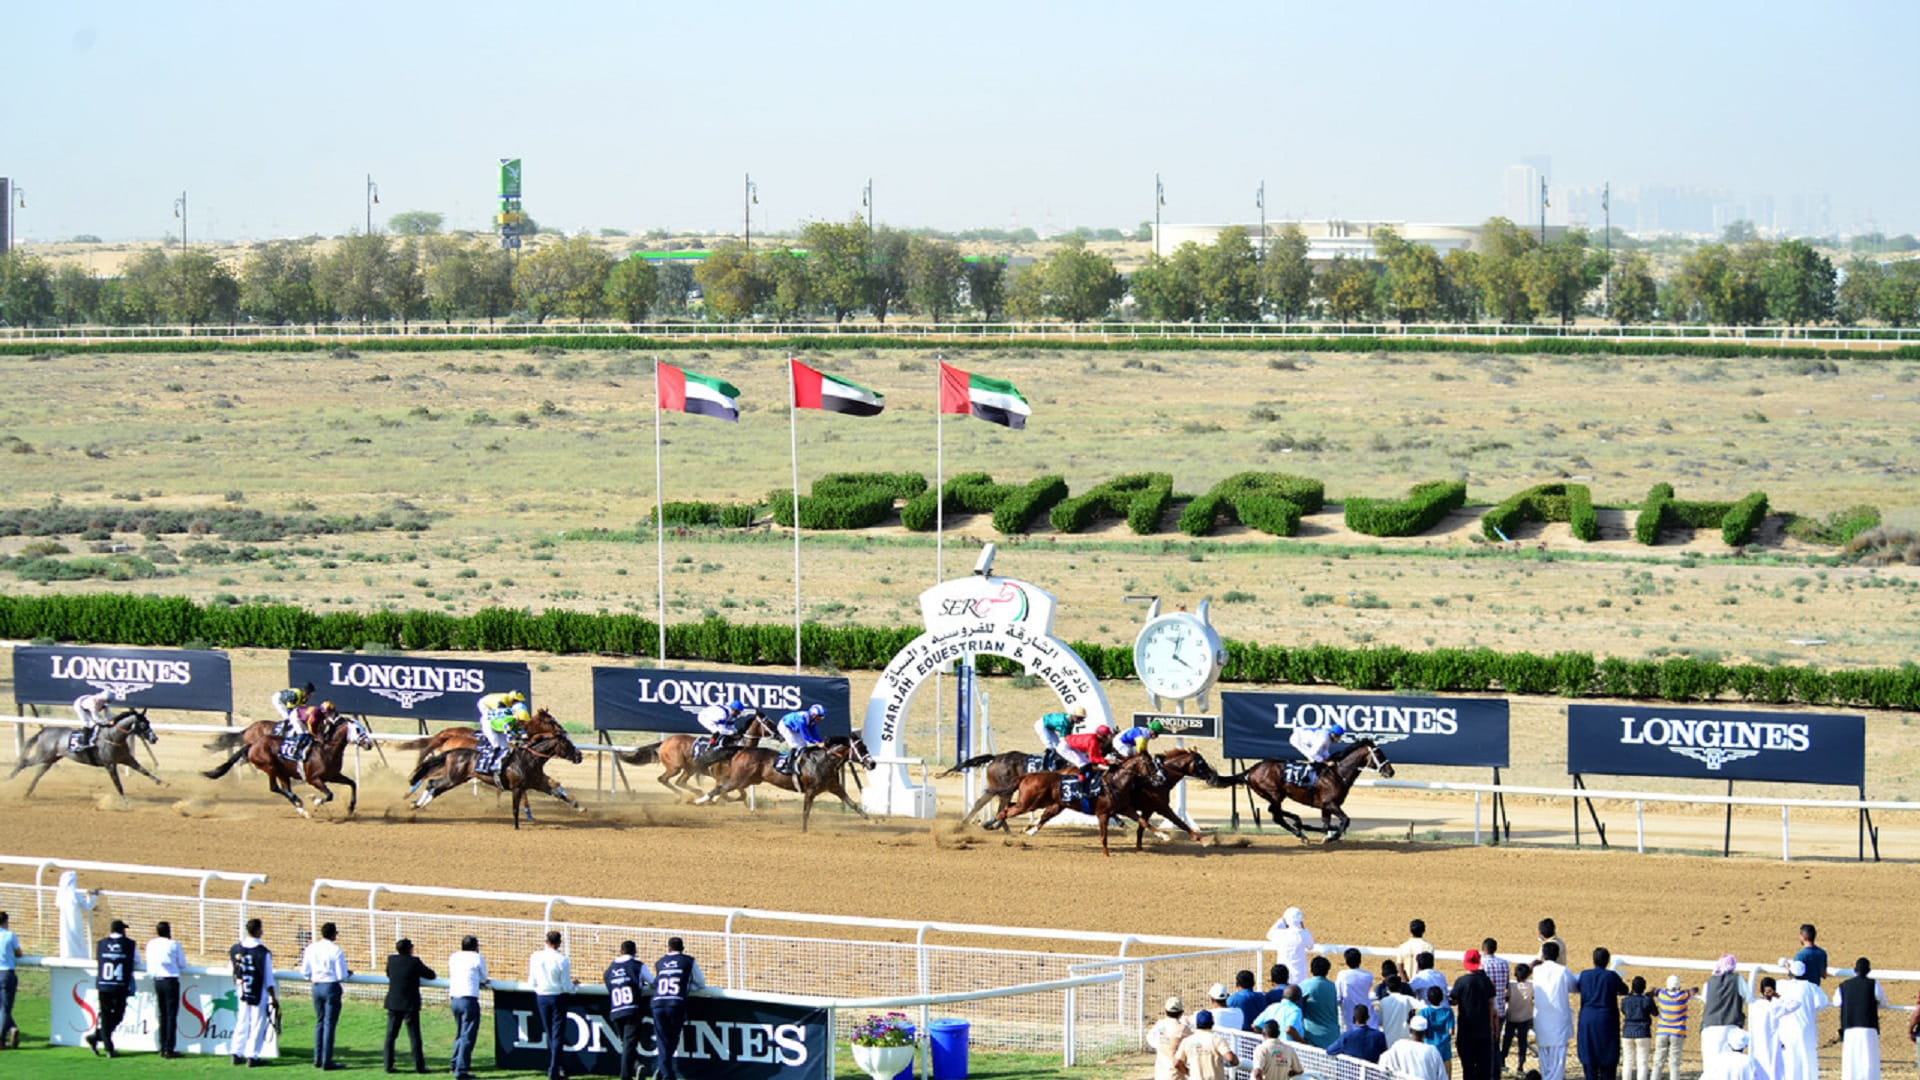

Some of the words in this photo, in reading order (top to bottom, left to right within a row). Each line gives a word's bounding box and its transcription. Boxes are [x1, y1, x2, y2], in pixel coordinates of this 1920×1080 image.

[1005, 623, 1059, 658] الشارقة
[50, 655, 192, 685] LONGINES
[330, 661, 486, 694] LONGINES
[638, 678, 803, 710] LONGINES
[881, 677, 915, 742] SHARJAH
[916, 640, 1005, 676] EQUESTRIAN
[1013, 647, 1023, 658] &
[1031, 657, 1077, 705] RACING
[1273, 703, 1459, 735] LONGINES
[1620, 717, 1810, 752] LONGINES
[1062, 784, 1072, 798] 3
[102, 962, 124, 981] 04
[657, 977, 681, 996] 05
[611, 986, 633, 1007] 08
